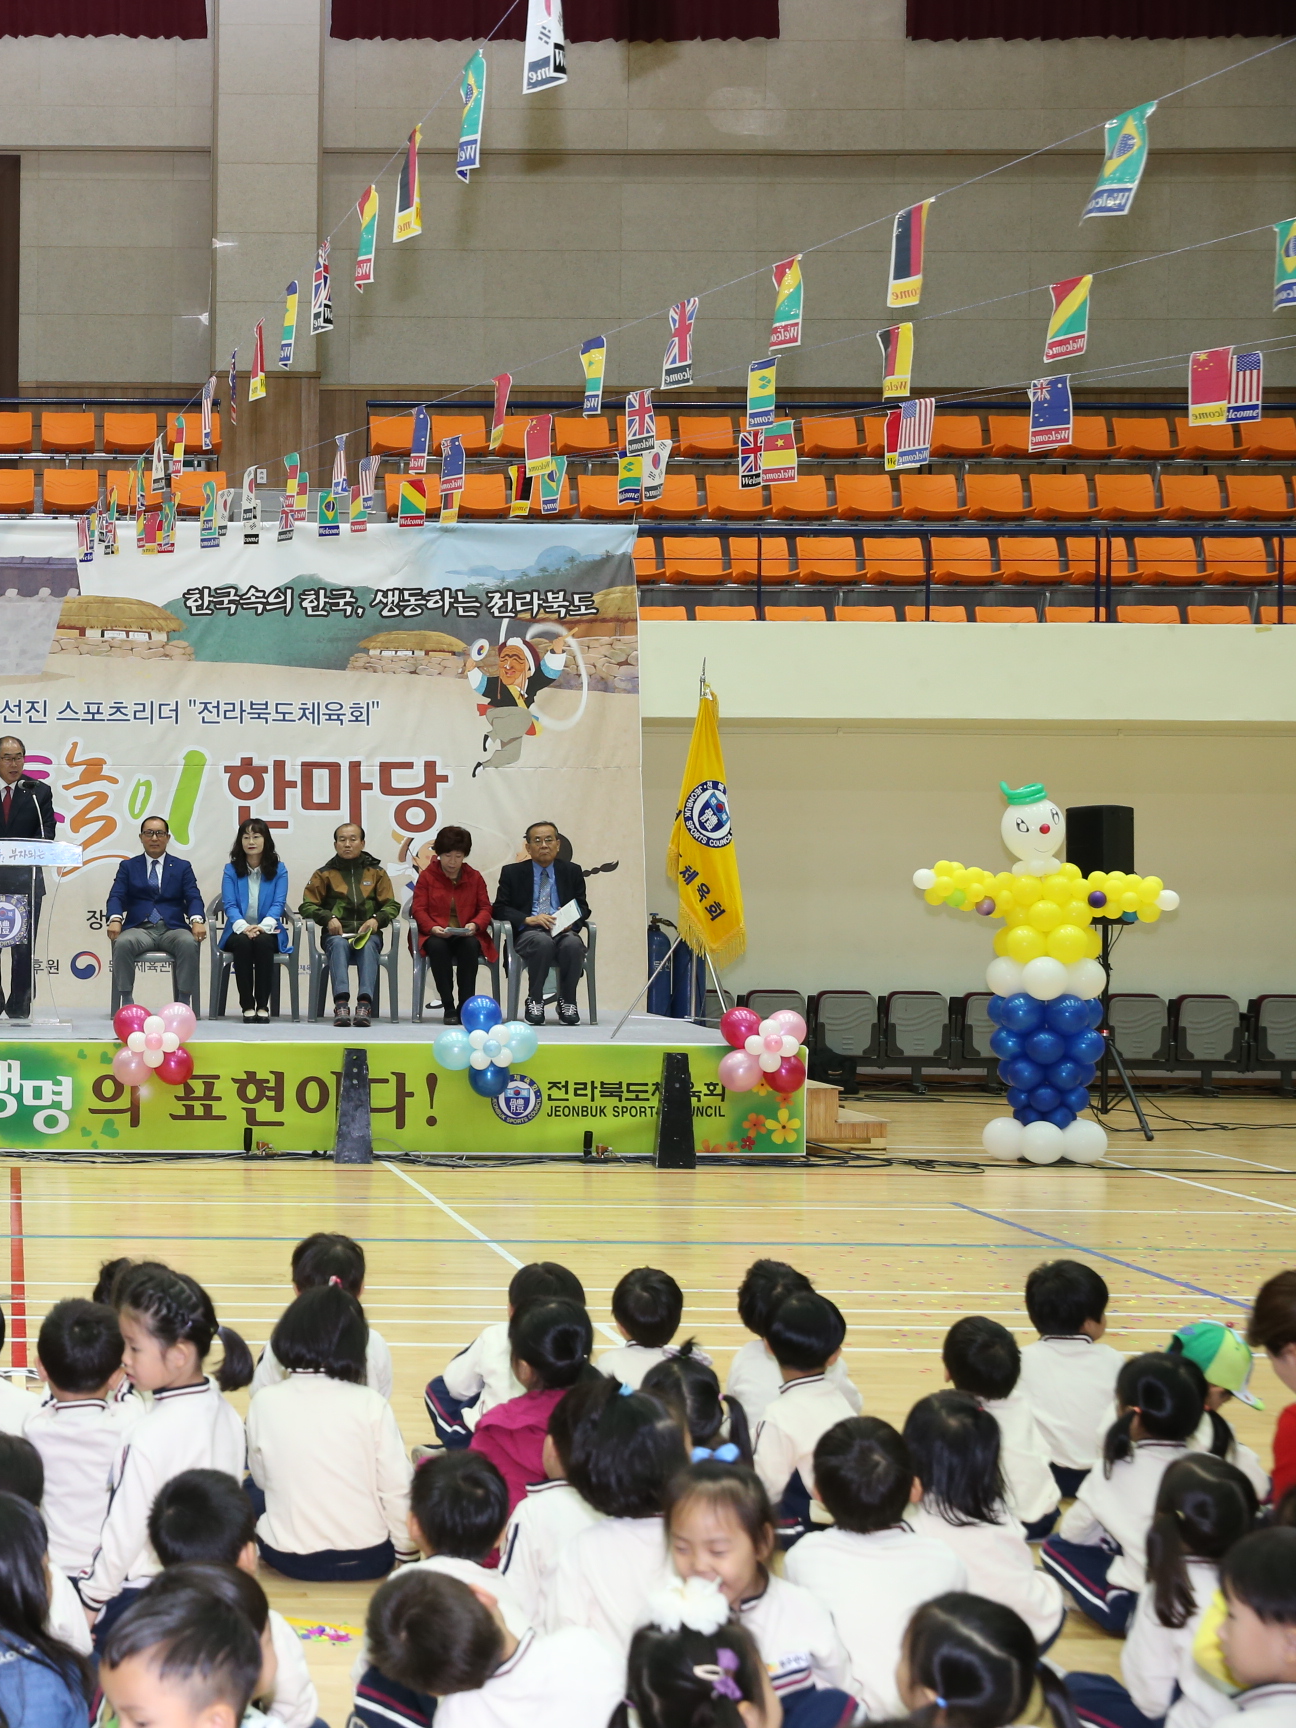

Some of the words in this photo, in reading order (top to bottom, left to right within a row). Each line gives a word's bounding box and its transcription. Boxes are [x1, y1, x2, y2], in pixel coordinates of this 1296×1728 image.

[400, 518, 424, 526] Welcome
[184, 586, 292, 616] 한국속의
[299, 586, 364, 618] 한국,
[371, 588, 481, 618] 생동하는
[486, 589, 599, 619] 전라북도
[0, 699, 48, 724] 선진
[56, 698, 180, 725] 스포츠리더
[188, 699, 381, 726] "전라북도체육회"
[224, 756, 449, 834] 한마당
[547, 1105, 607, 1118] JEONBUK
[612, 1105, 658, 1118] SPORT
